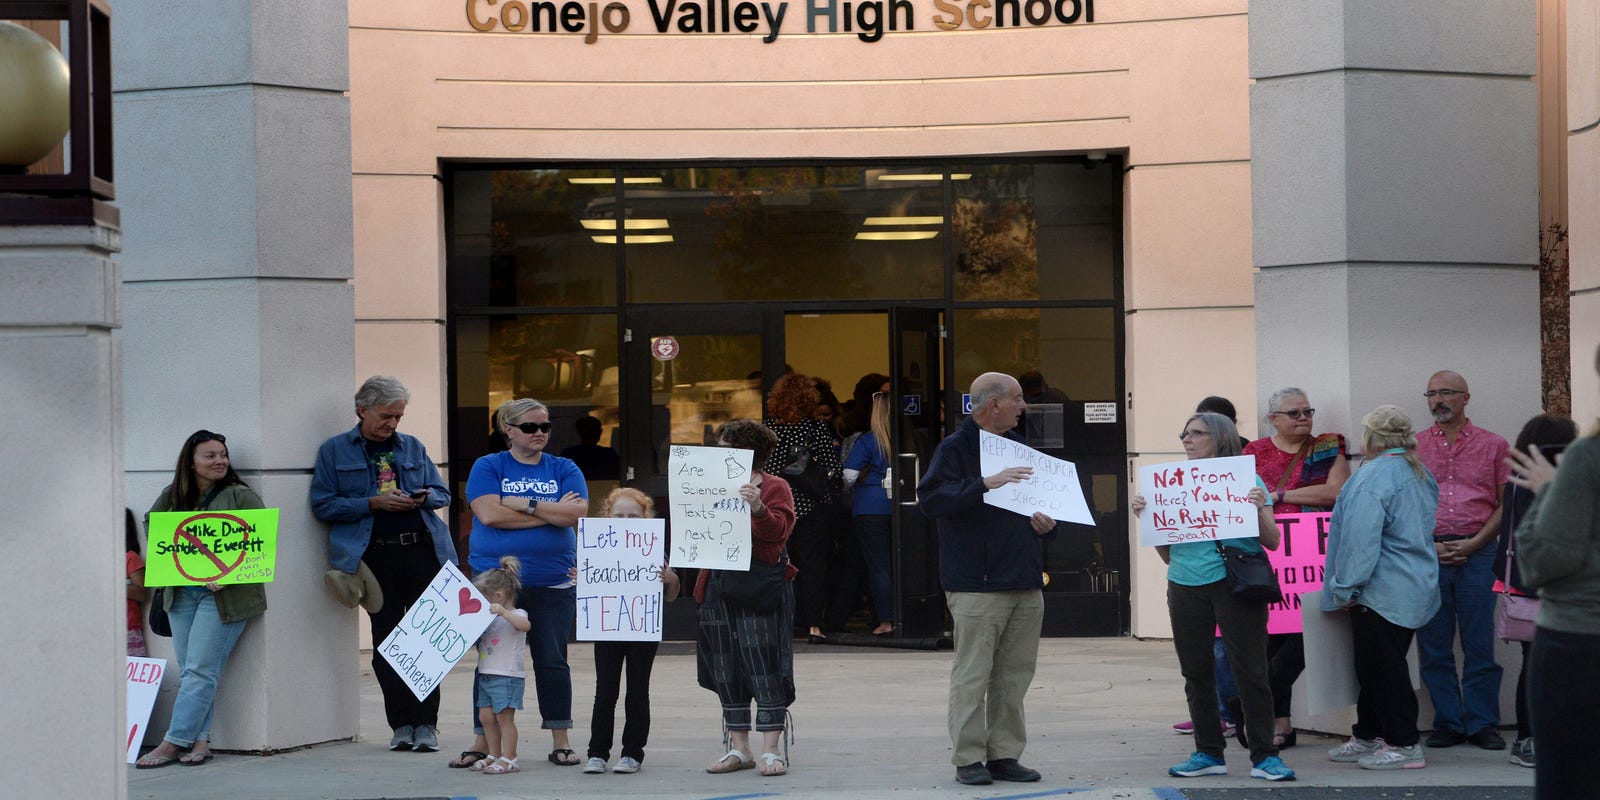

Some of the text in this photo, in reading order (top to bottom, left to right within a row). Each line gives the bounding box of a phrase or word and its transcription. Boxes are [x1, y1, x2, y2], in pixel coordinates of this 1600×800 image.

[465, 0, 1095, 44] Conejo Valley High School
[981, 435, 1074, 479] KEEP YOUR CHURCH
[678, 463, 705, 477] Are
[1153, 467, 1185, 489] Not
[681, 482, 727, 496] Science
[1154, 486, 1251, 507] Here? You hav
[678, 504, 716, 520] Texts
[1153, 508, 1244, 529] No Right to
[186, 522, 217, 537] Mike
[579, 518, 659, 557] Let my
[1167, 527, 1218, 543] Speak!
[213, 537, 264, 555] Everett
[236, 567, 273, 582] CVUSD
[580, 557, 658, 584] teachers
[431, 567, 461, 602] I
[576, 591, 661, 634] TEACH!
[411, 598, 468, 663] CVUSD
[383, 624, 444, 697] Teachers!
